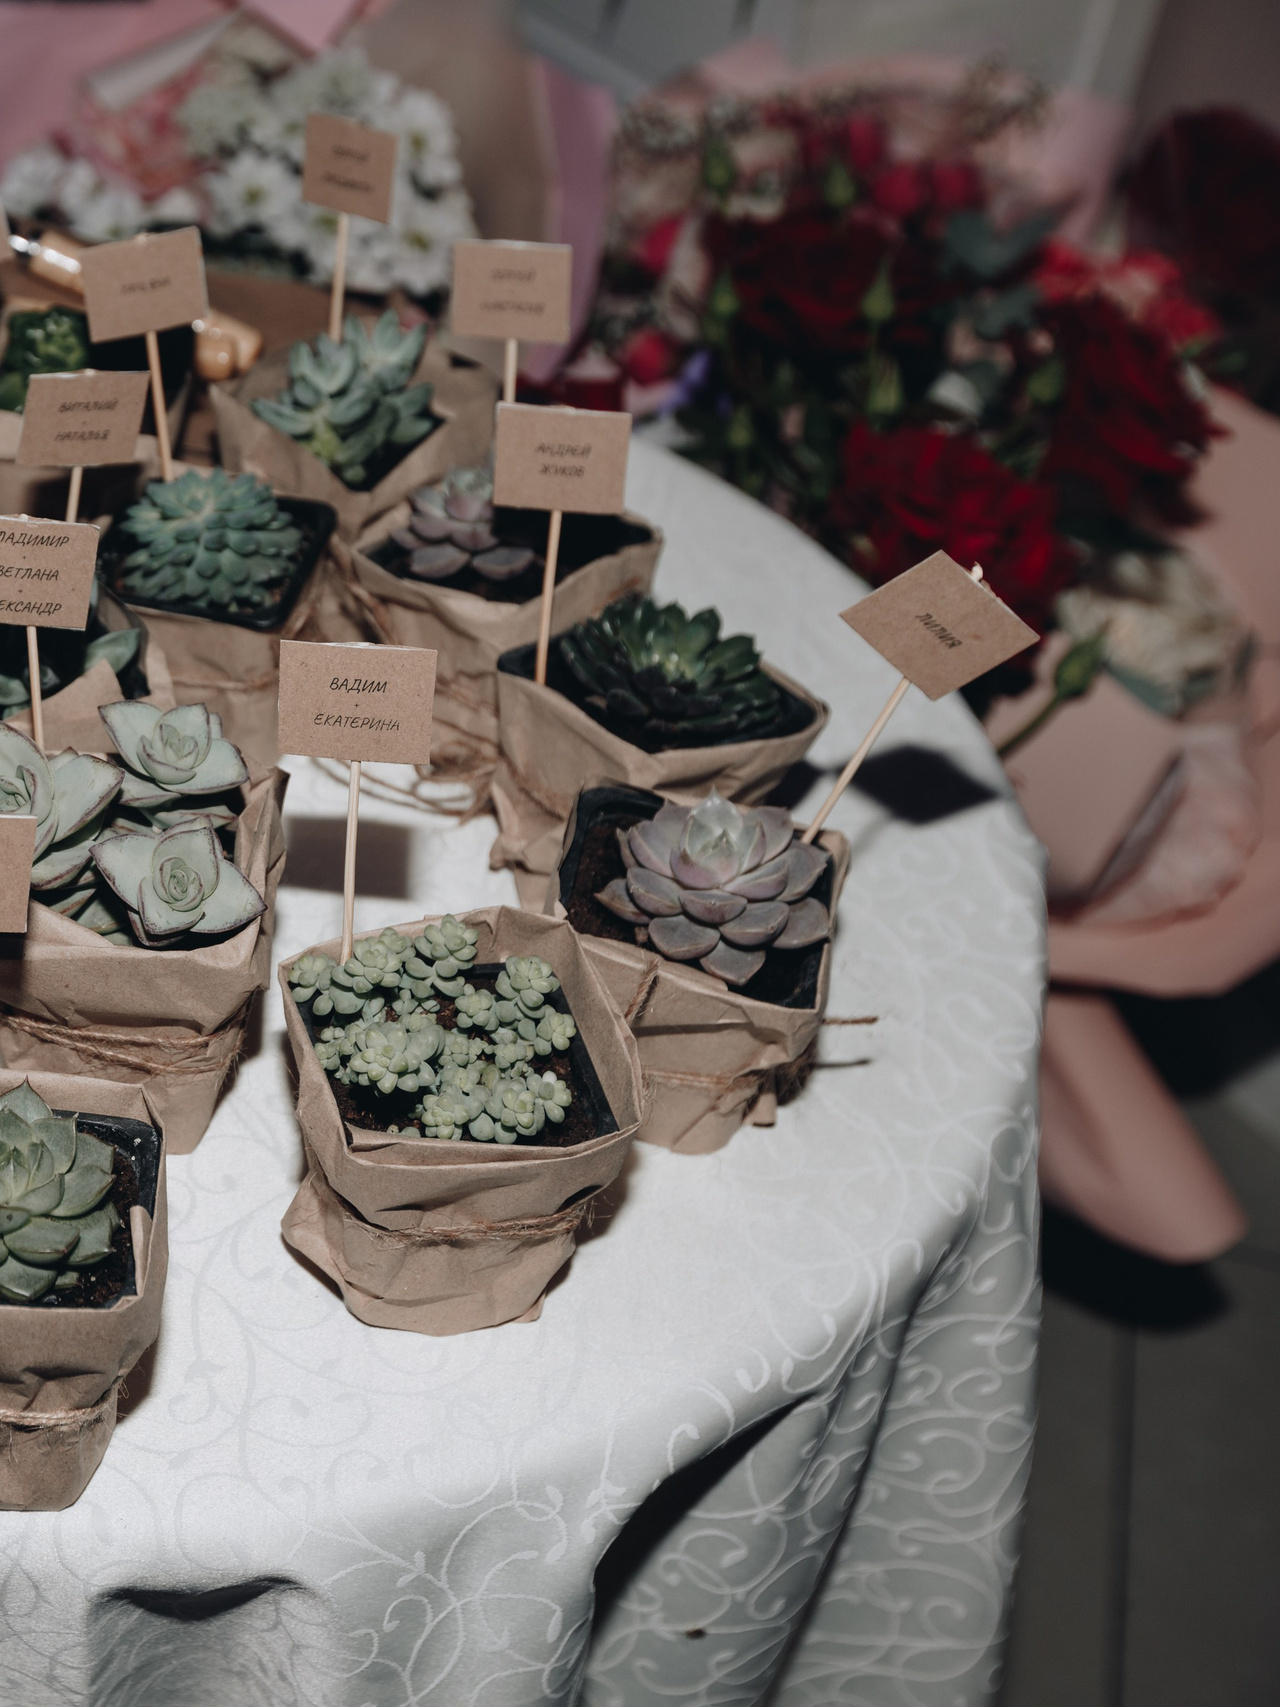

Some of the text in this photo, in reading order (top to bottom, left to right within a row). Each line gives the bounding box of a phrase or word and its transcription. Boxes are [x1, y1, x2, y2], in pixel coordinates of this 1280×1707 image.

[58, 397, 119, 412] ВИТАЛИЙ
[54, 429, 111, 441] НАТАЛЬЯ
[914, 612, 964, 649] ЛИЛИЯ
[329, 677, 388, 694] ВАДИМ
[314, 713, 400, 731] ЕКАТЕРИНА
